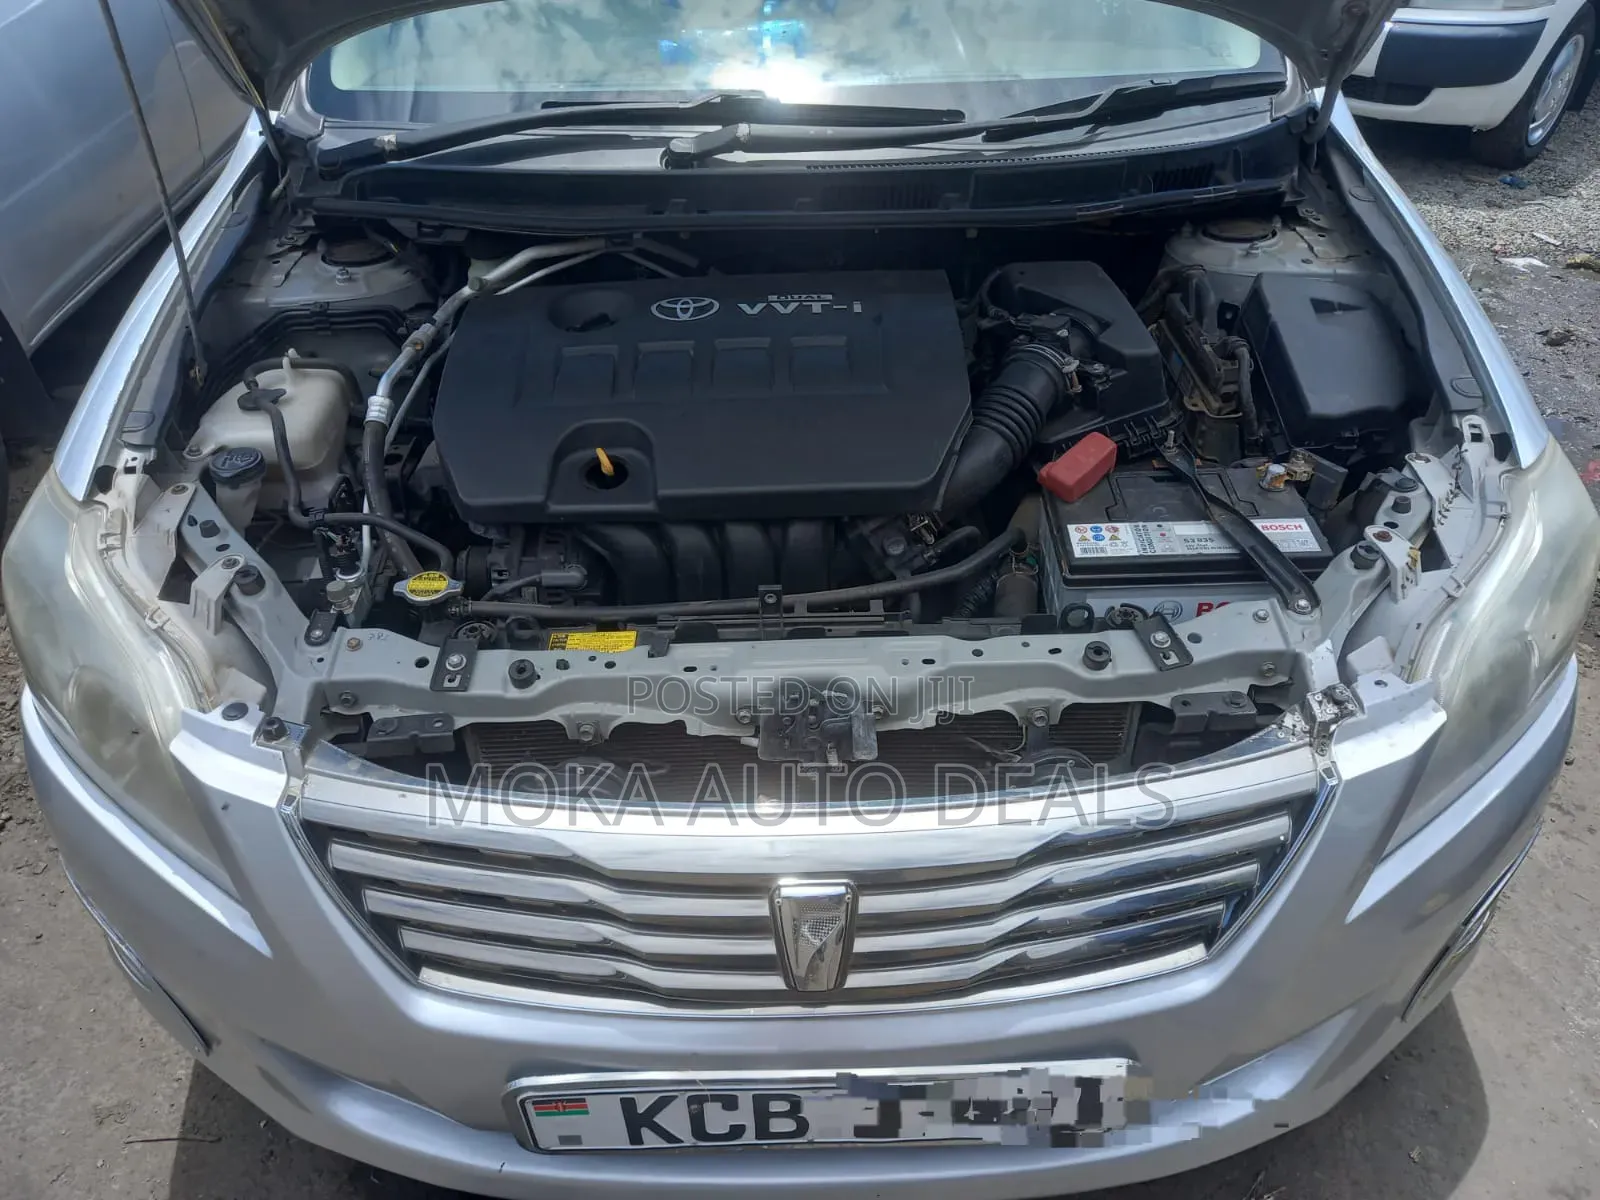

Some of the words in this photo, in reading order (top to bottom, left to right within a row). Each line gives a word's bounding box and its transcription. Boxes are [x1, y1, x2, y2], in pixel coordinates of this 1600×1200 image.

[736, 301, 863, 315] VVT-i
[1260, 523, 1304, 532] BOSCH
[619, 1092, 810, 1147] KCB
